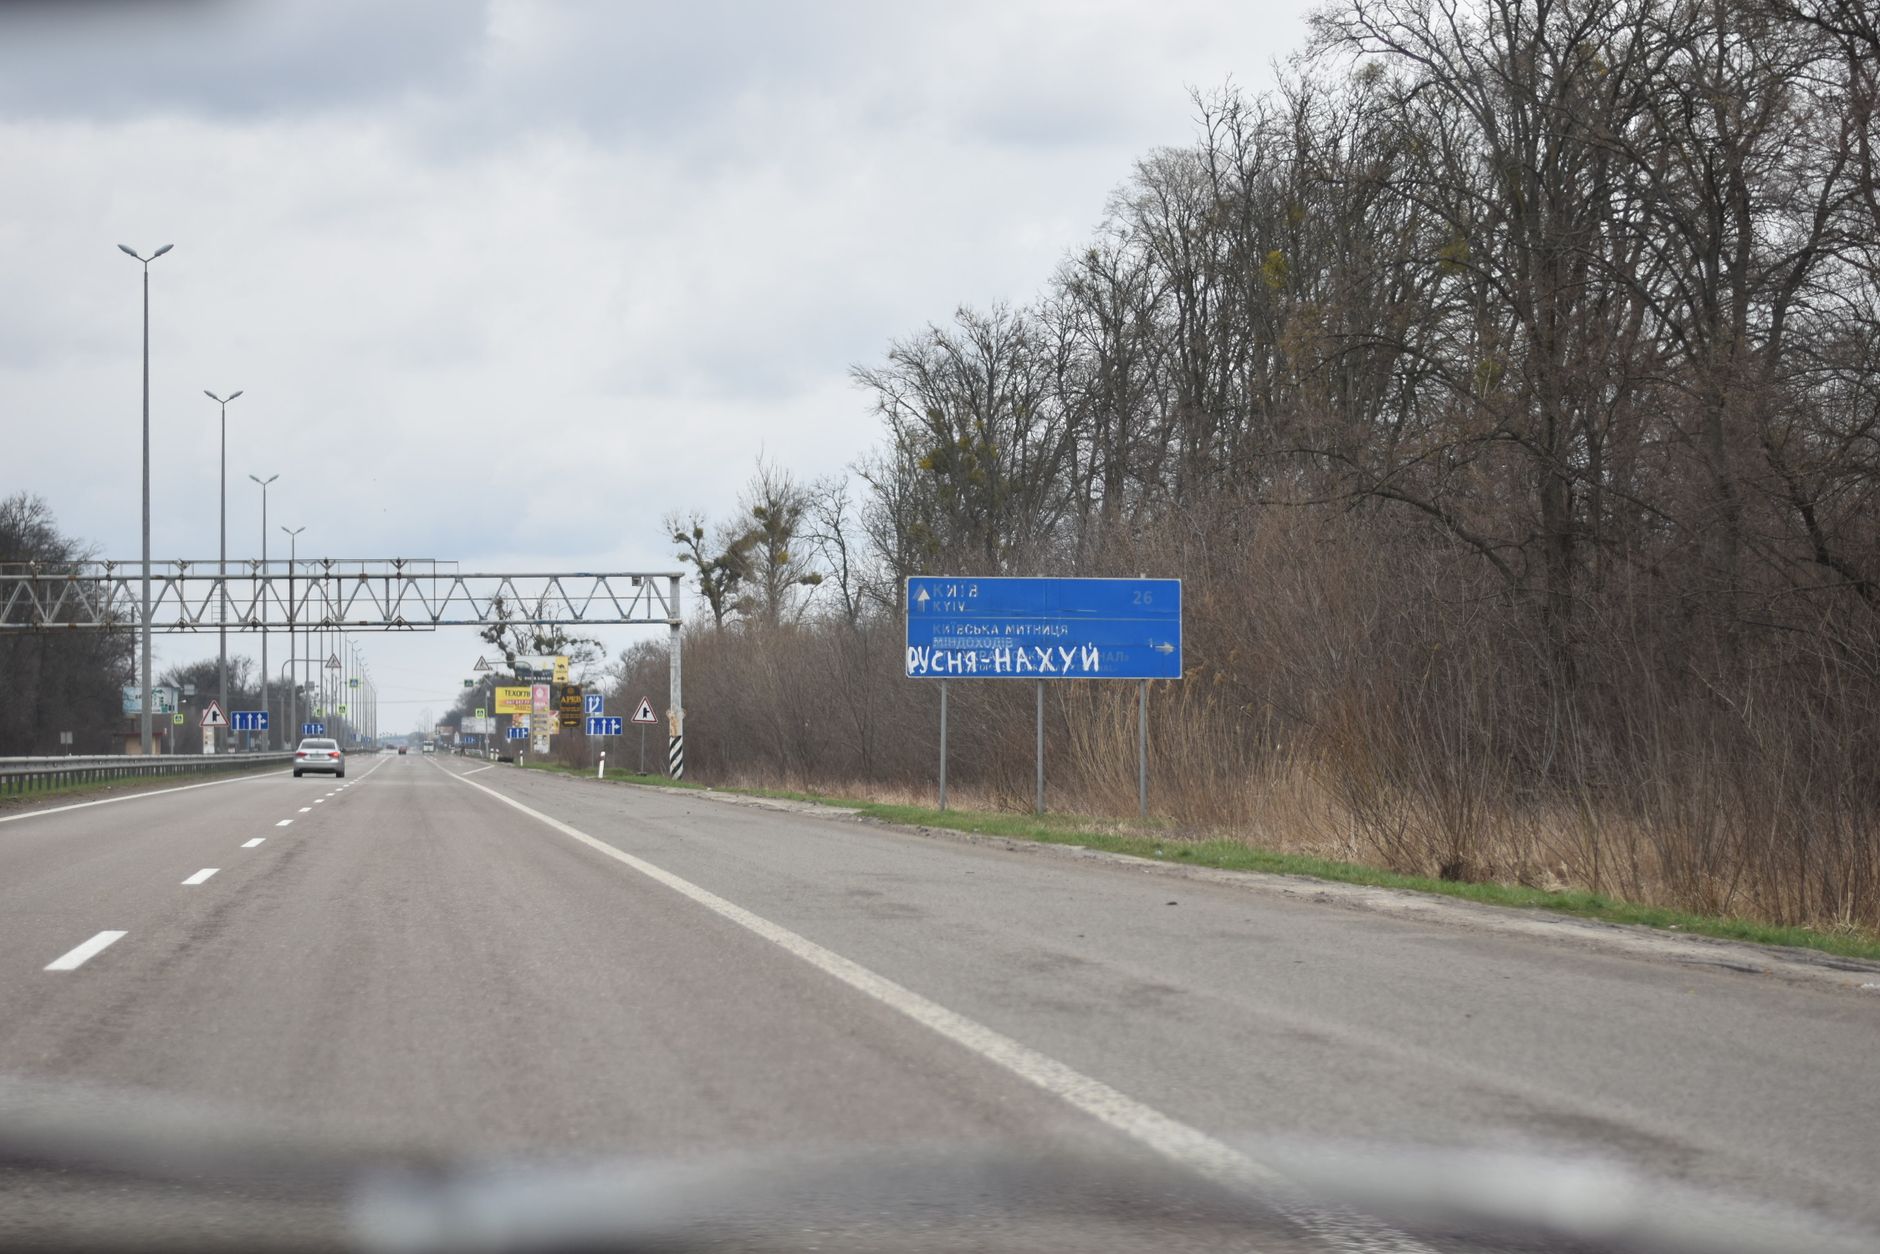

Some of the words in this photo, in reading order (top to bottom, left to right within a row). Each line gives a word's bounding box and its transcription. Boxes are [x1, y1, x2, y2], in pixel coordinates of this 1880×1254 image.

[1133, 591, 1153, 605] 26
[933, 601, 966, 612] KYIV
[932, 623, 999, 635] КИЇВСЬКА
[1005, 624, 1068, 637] МИТНИЦЯ
